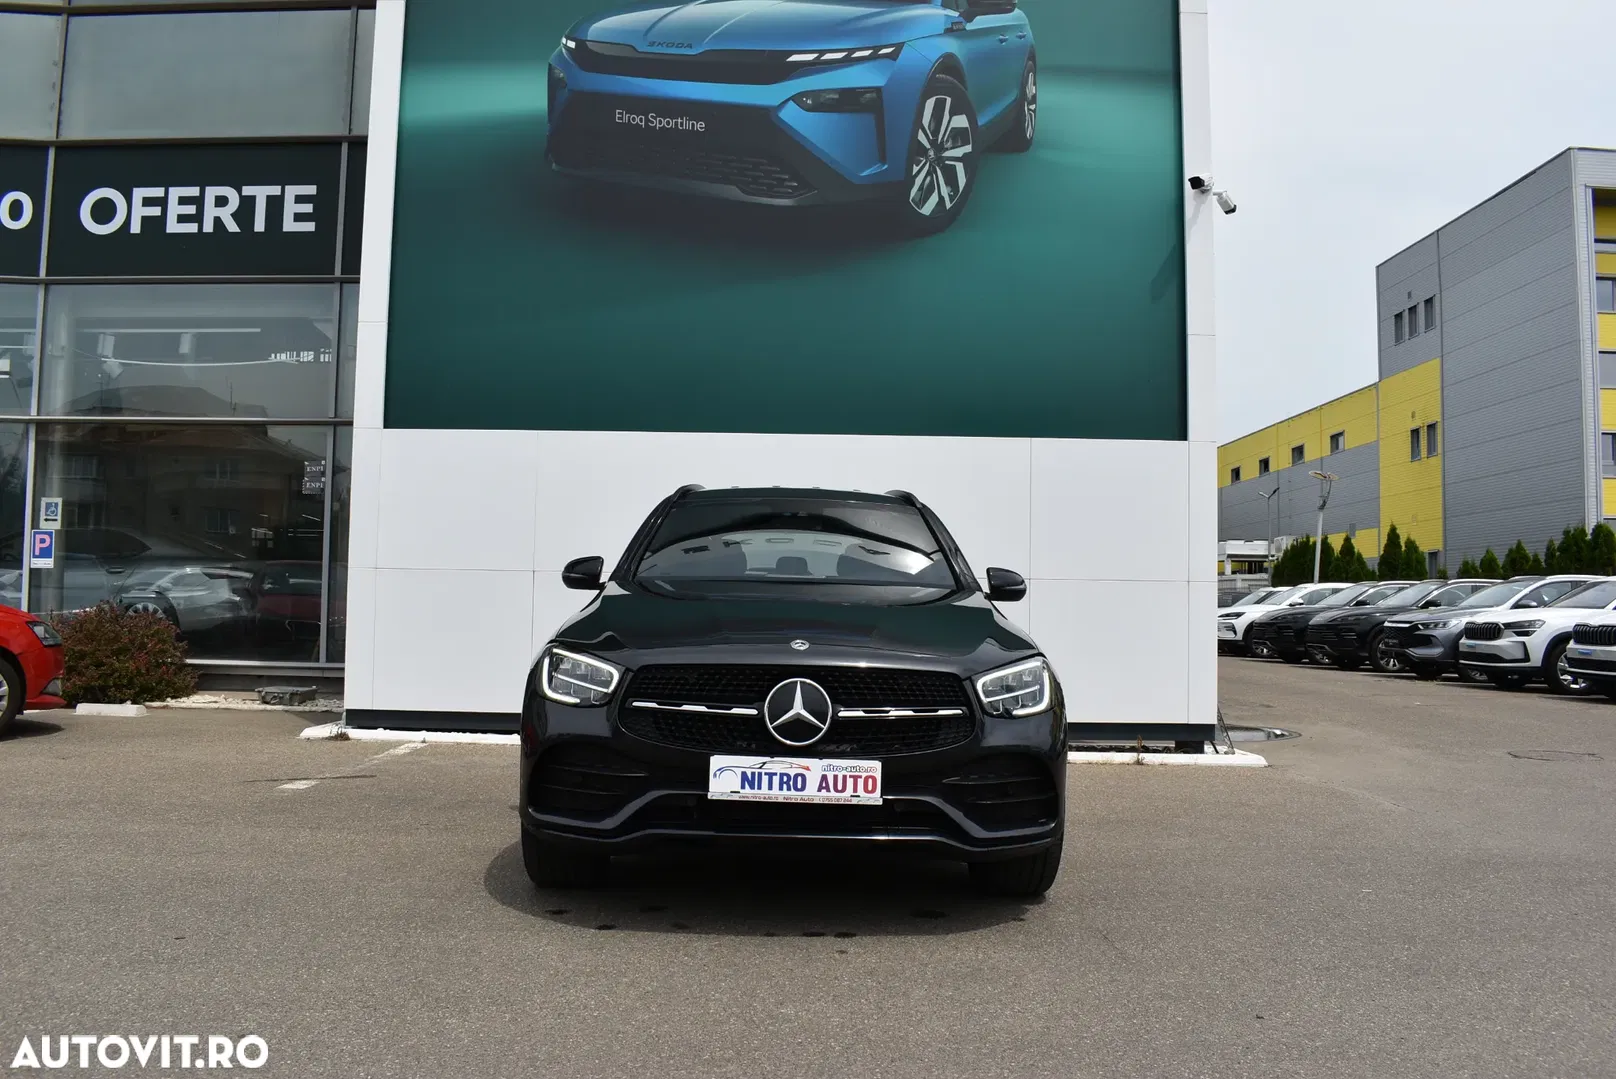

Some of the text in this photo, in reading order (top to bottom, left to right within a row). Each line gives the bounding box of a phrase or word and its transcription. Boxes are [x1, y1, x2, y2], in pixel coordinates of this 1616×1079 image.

[615, 109, 706, 132] Elroq Sportline
[79, 185, 318, 235] OFERTE
[34, 533, 51, 556] P
[821, 763, 878, 773] nitro-auto.ro
[740, 771, 878, 794] NITRO AUTO
